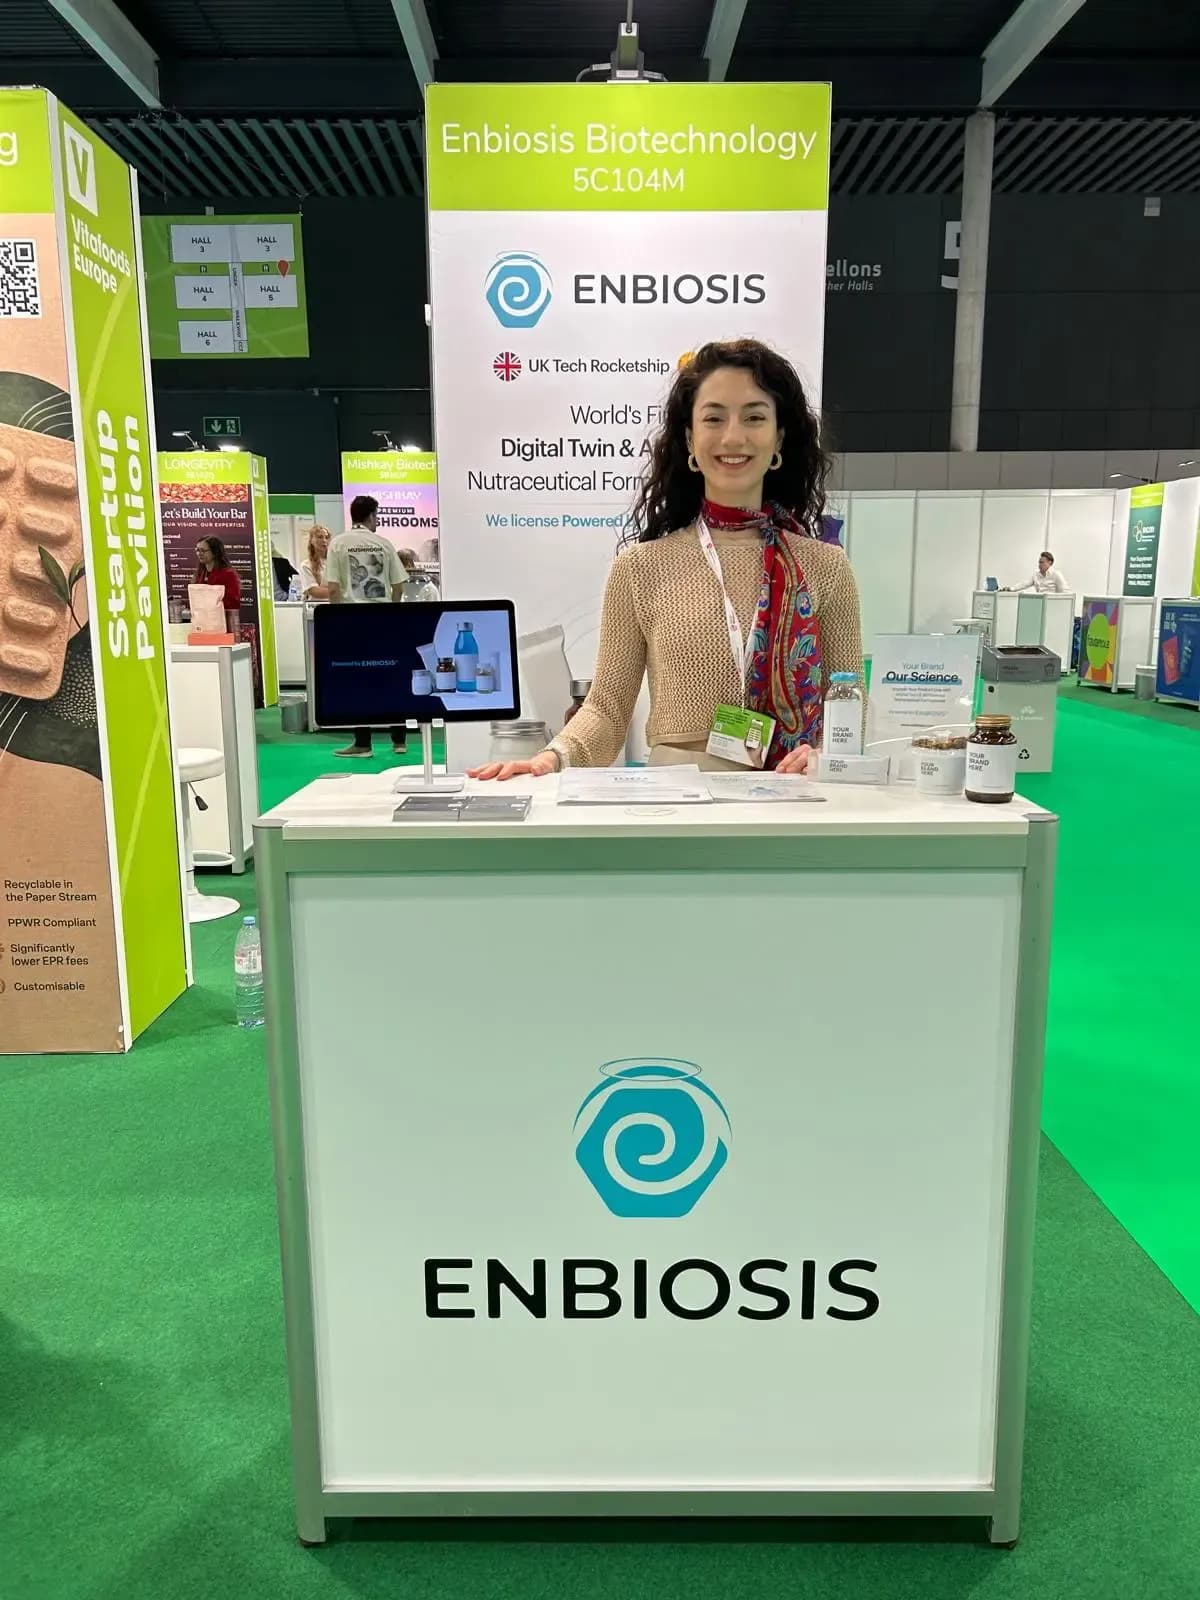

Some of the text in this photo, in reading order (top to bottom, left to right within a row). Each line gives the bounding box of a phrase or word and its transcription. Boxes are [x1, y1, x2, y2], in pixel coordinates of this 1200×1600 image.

[441, 123, 818, 161] Enbiosis Biotechnology
[572, 167, 685, 193] 5C104M
[71, 214, 131, 278] Vitafoods
[256, 236, 278, 244] HALL
[73, 245, 118, 294] Europe
[826, 259, 882, 277] ellons
[260, 285, 281, 293] HALL
[573, 273, 767, 305] ENBIOSIS
[847, 280, 874, 291] Halls
[528, 359, 670, 375] UK Tech Rocketship
[570, 405, 642, 425] World's
[501, 438, 564, 461] Digital
[567, 438, 615, 457] Twin
[619, 439, 635, 457] &
[164, 458, 234, 470] LONGEVITY
[347, 458, 393, 470] Mishkay
[468, 470, 597, 491] Nutraceutical
[161, 507, 248, 519] et's Build Your Bar
[486, 514, 509, 527] We
[511, 514, 559, 527] license
[562, 514, 623, 527] Powered
[97, 410, 129, 658] Startup
[125, 415, 155, 660] Pavilion
[903, 662, 945, 670] Your Brand
[886, 671, 959, 683] Our Science
[968, 758, 990, 766] BRAND
[4, 879, 73, 891] Recyclable in
[6, 892, 97, 904] the Paper Stream
[8, 917, 97, 929] PPWR Compliant
[10, 943, 75, 955] Significantly
[11, 956, 89, 966] lower EPR fees
[14, 982, 86, 991] Customisable
[424, 1258, 881, 1321] ENBIOSIS
